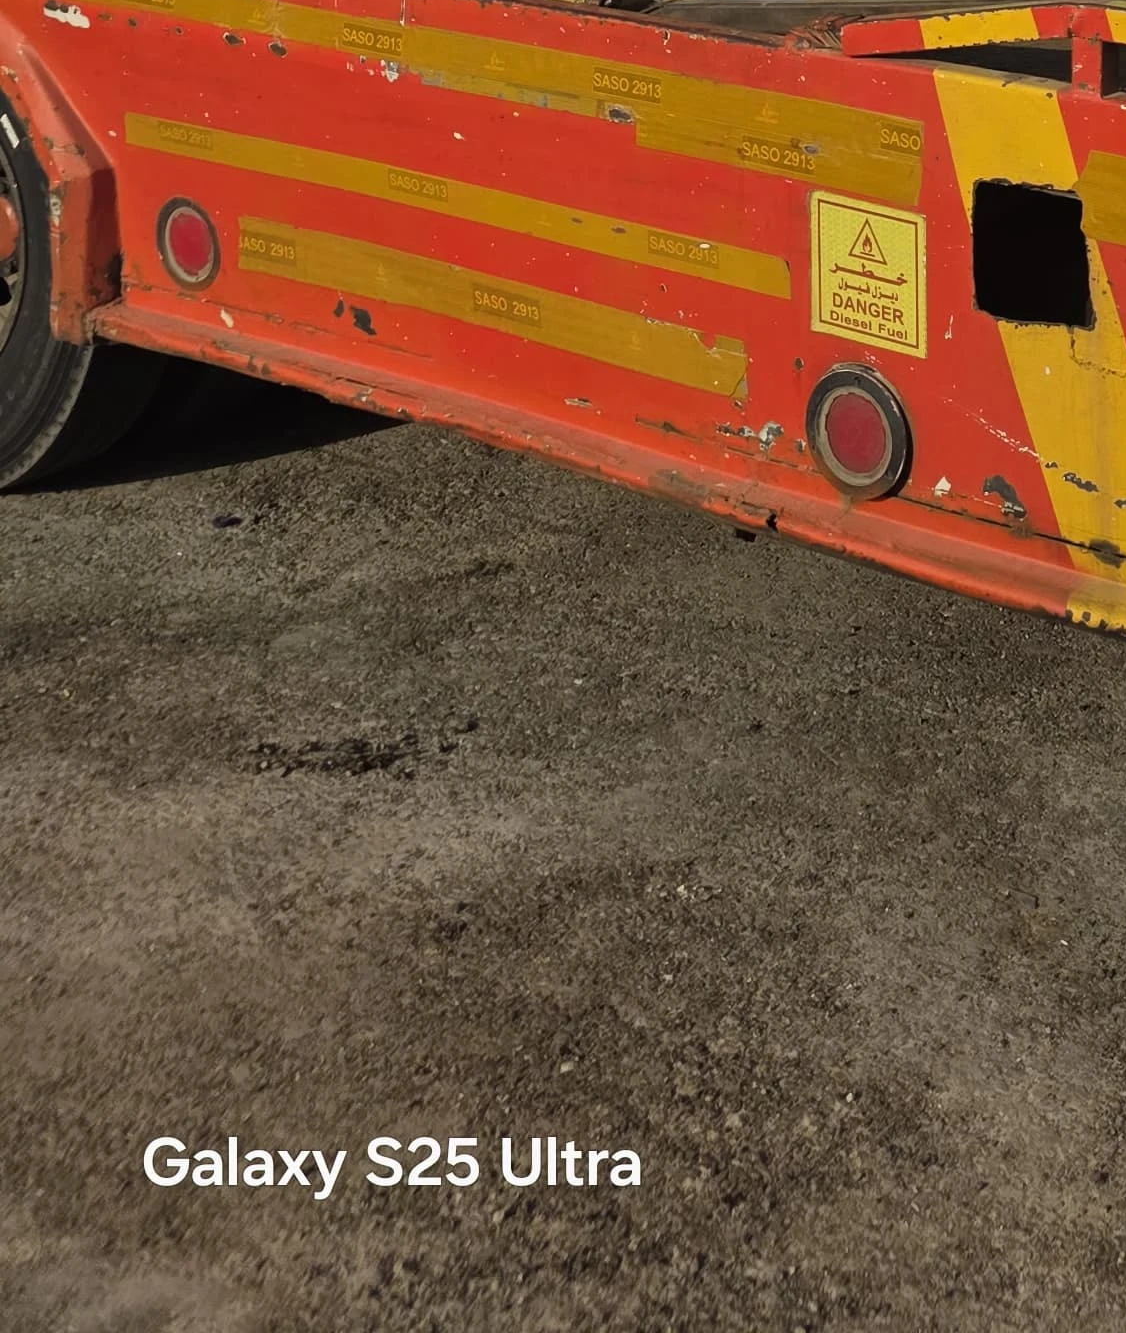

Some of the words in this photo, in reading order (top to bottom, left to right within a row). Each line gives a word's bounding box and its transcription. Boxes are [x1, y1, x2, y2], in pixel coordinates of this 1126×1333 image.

[343, 28, 374, 47] SASO
[375, 35, 403, 53] 2913
[592, 72, 629, 92] SASO
[631, 79, 662, 100] 2913
[880, 128, 921, 151] SASO
[742, 140, 781, 163] SASO
[783, 149, 816, 171] 2913
[389, 173, 420, 192] SASO
[421, 180, 448, 199] 2913
[270, 242, 296, 261] 2913
[649, 236, 686, 256] SASO
[688, 244, 718, 265] 2913
[828, 262, 908, 286] خطر
[474, 290, 508, 312] SASO
[512, 300, 540, 321] 2913
[832, 291, 905, 326] DANGER
[830, 309, 873, 332] Diesel
[878, 322, 908, 341] Fuel
